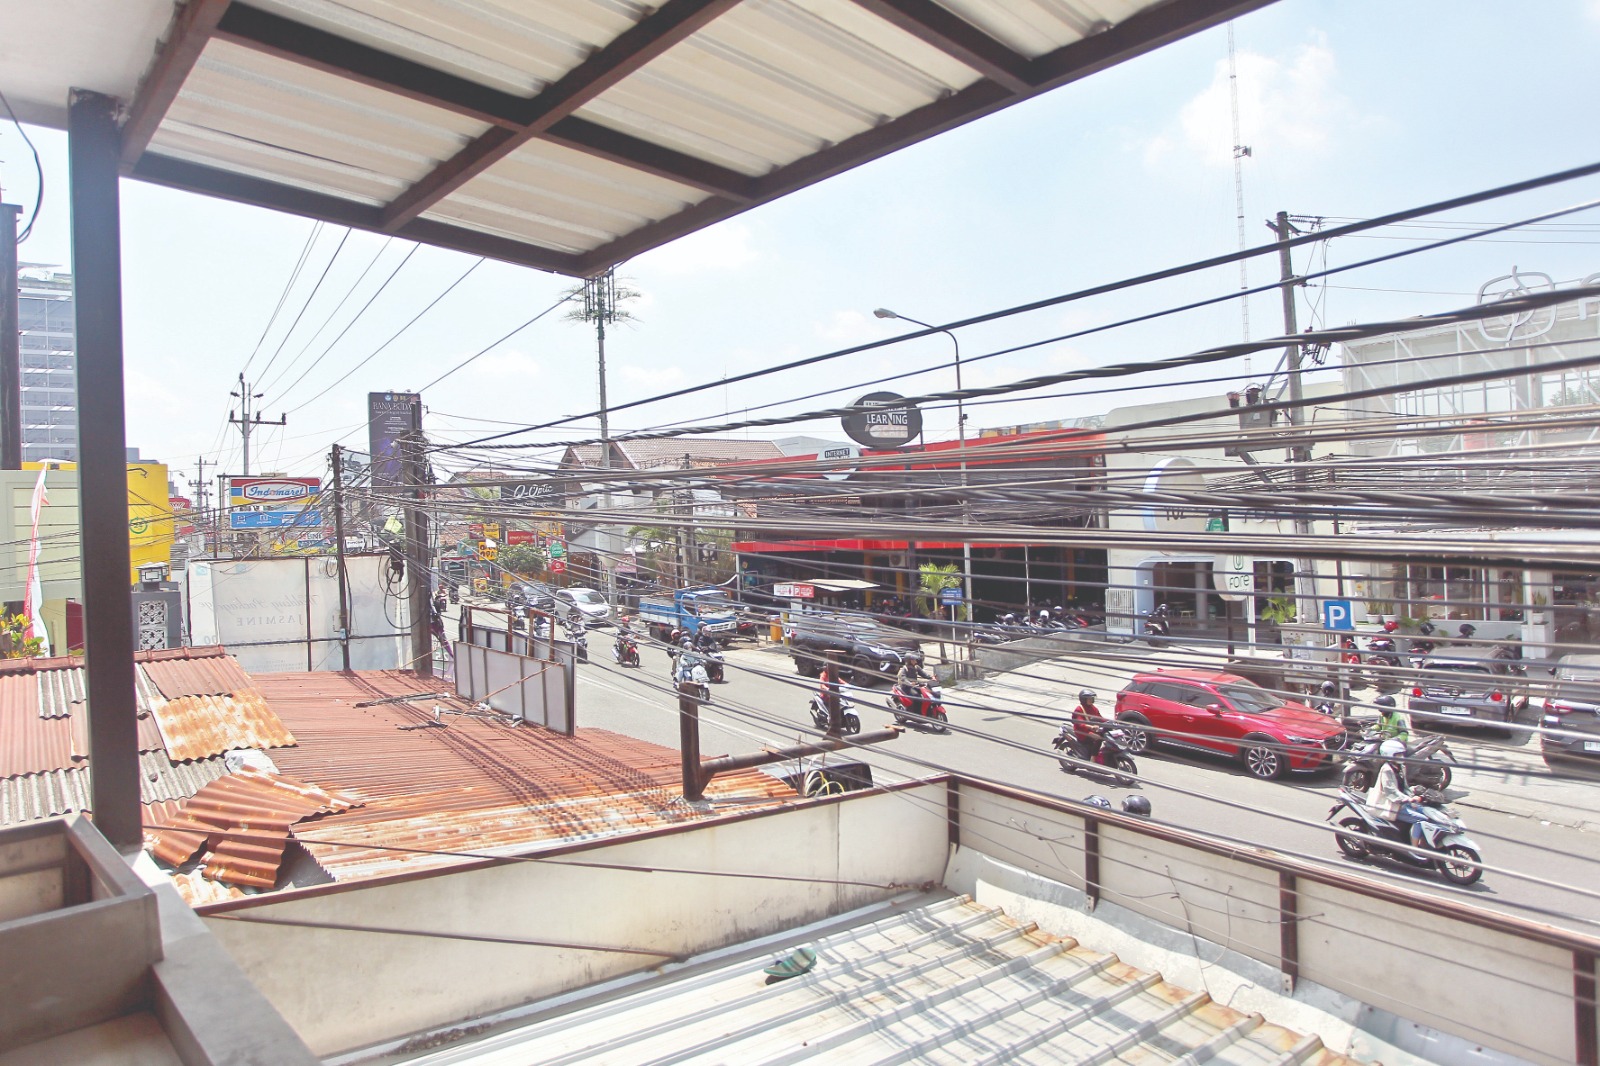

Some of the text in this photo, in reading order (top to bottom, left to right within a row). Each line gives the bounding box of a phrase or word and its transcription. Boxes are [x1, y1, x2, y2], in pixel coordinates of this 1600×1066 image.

[866, 413, 908, 425] LEARNING
[825, 448, 849, 458] INTERNET
[248, 486, 304, 496] Indomaret
[1328, 605, 1346, 628] P
